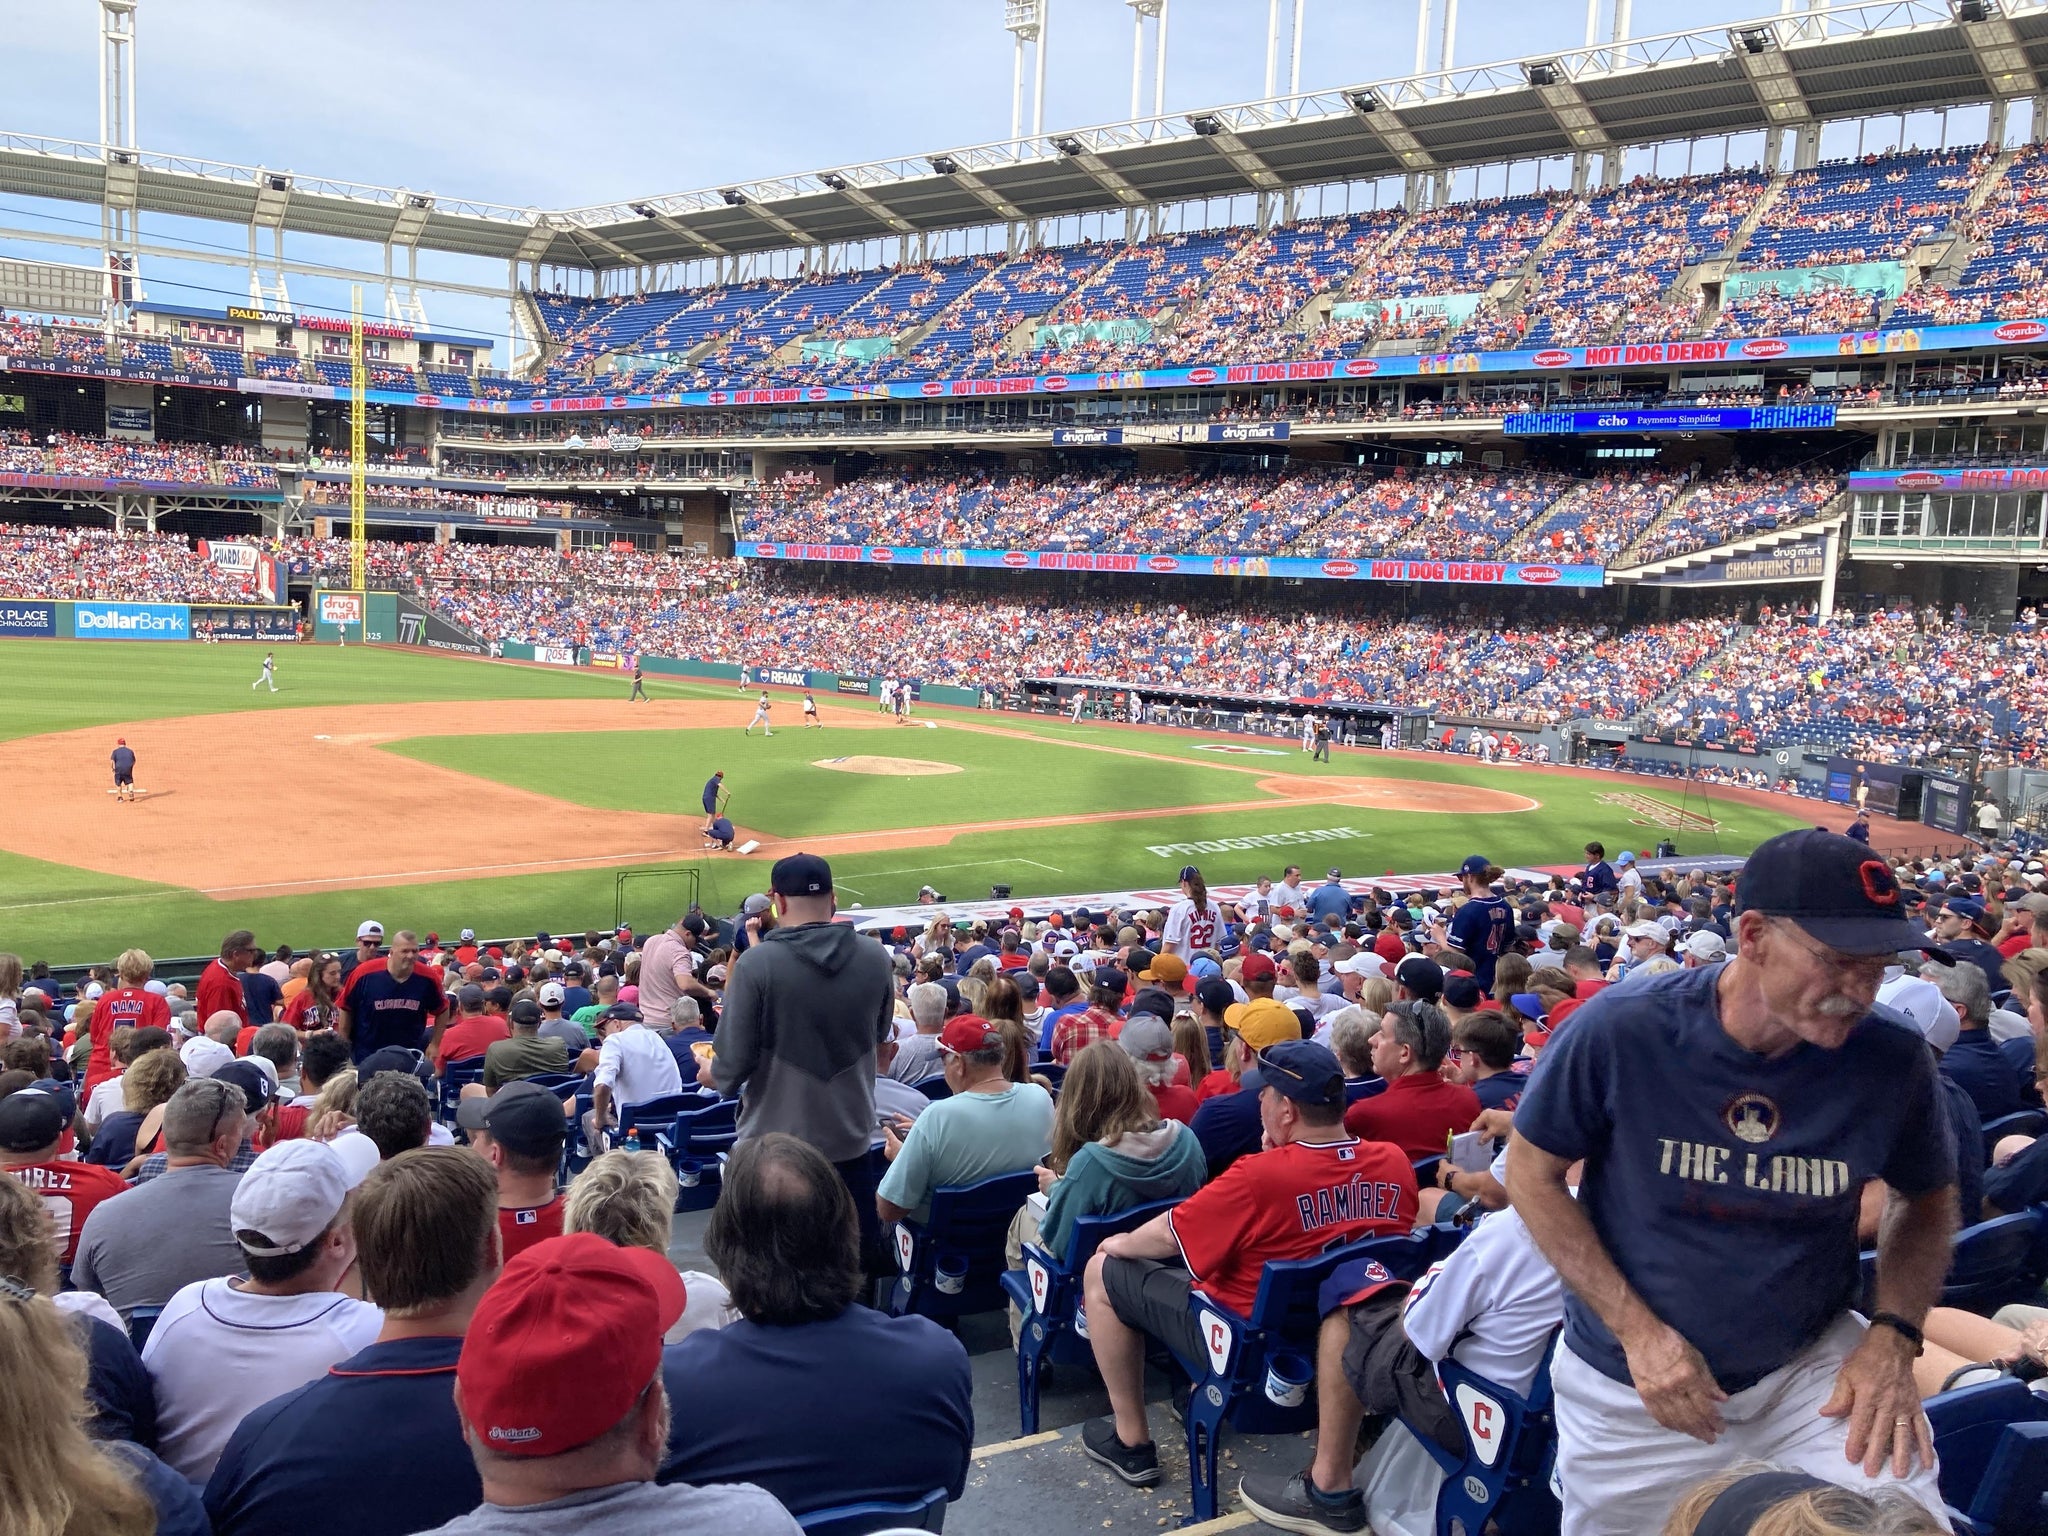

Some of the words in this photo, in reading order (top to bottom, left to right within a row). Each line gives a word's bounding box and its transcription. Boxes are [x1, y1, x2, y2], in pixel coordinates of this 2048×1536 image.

[300, 314, 358, 333] PENNAN
[362, 320, 415, 339] DISTRICT
[1111, 326, 1139, 339] WYNN
[1995, 323, 2045, 339] Sugardale
[1585, 347, 1622, 366] HOT
[1624, 345, 1663, 364] DOG
[1666, 341, 1730, 362] DERBY
[1742, 342, 1788, 355] Sugardale
[17, 360, 26, 369] 31
[1532, 352, 1572, 366] Sugardale
[42, 362, 56, 372] 1-0
[72, 365, 89, 374] 31.2
[105, 368, 122, 377] 1.99
[1227, 366, 1253, 381] HOT
[1257, 364, 1285, 380] DOG
[1289, 362, 1335, 379] DERBY
[1344, 361, 1379, 375] Sugardale
[139, 371, 156, 381] 5.74
[174, 374, 190, 384] 6.03
[212, 378, 229, 387] 1.49
[1188, 370, 1217, 382] Sugardale
[951, 380, 974, 396] HOT
[975, 379, 998, 394] DOG
[999, 377, 1036, 393] DERBY
[734, 390, 753, 403] HOT
[753, 389, 772, 403] DOG
[773, 388, 802, 402] DERBY
[551, 399, 566, 411] HOT
[566, 398, 581, 410] DOG
[582, 397, 606, 410] DERBY
[1598, 415, 1628, 427] echo
[1637, 415, 1677, 426] Payments
[1678, 413, 1721, 425] Simplified
[1062, 431, 1084, 444] drug
[1085, 431, 1108, 442] mart
[1122, 426, 1180, 444] CHAMPIONS
[1181, 425, 1209, 442] CLUB
[1222, 427, 1247, 440] drug
[1248, 427, 1275, 438] mart
[592, 436, 610, 449] kids
[325, 460, 346, 470] FAT
[1895, 474, 1944, 487] Sugardale
[477, 501, 495, 516] THE
[496, 502, 539, 519] CORNER
[214, 547, 240, 565] GUARDS
[785, 544, 805, 558] HOT
[806, 545, 829, 560] DOG
[830, 546, 863, 561] DERBY
[1773, 547, 1796, 559] drug
[1797, 545, 1822, 557] mart
[1039, 552, 1065, 568] HOT
[1066, 553, 1094, 569] DOG
[1095, 554, 1139, 571] DERBY
[1725, 558, 1791, 579] CHAMPIONS
[1793, 557, 1823, 574] CLUB
[1321, 563, 1359, 576] Sugardale
[1371, 561, 1405, 579] HOT
[1408, 562, 1447, 580] DOG
[1448, 563, 1507, 583] DERBY
[1518, 568, 1562, 581] Sugardale
[323, 597, 354, 612] drug
[7, 609, 48, 621] PLACE
[326, 610, 361, 621] mart
[366, 632, 382, 640] 325
[545, 647, 568, 662] ROSE
[1145, 826, 1374, 858] PROGRESSIVE
[1860, 860, 1899, 905] C
[1190, 924, 1215, 949] 22
[111, 1000, 144, 1015] NANA
[1657, 1138, 1730, 1184] THE
[1745, 1152, 1849, 1197] LAND
[1296, 1173, 1402, 1232] RAMÍREZ
[902, 1234, 909, 1257] C
[1035, 1270, 1044, 1297] C
[1211, 1324, 1224, 1355] C
[1209, 1388, 1220, 1403] CC
[1473, 1402, 1492, 1440] C
[488, 1426, 542, 1442] Indians
[1468, 1480, 1486, 1499] DD
